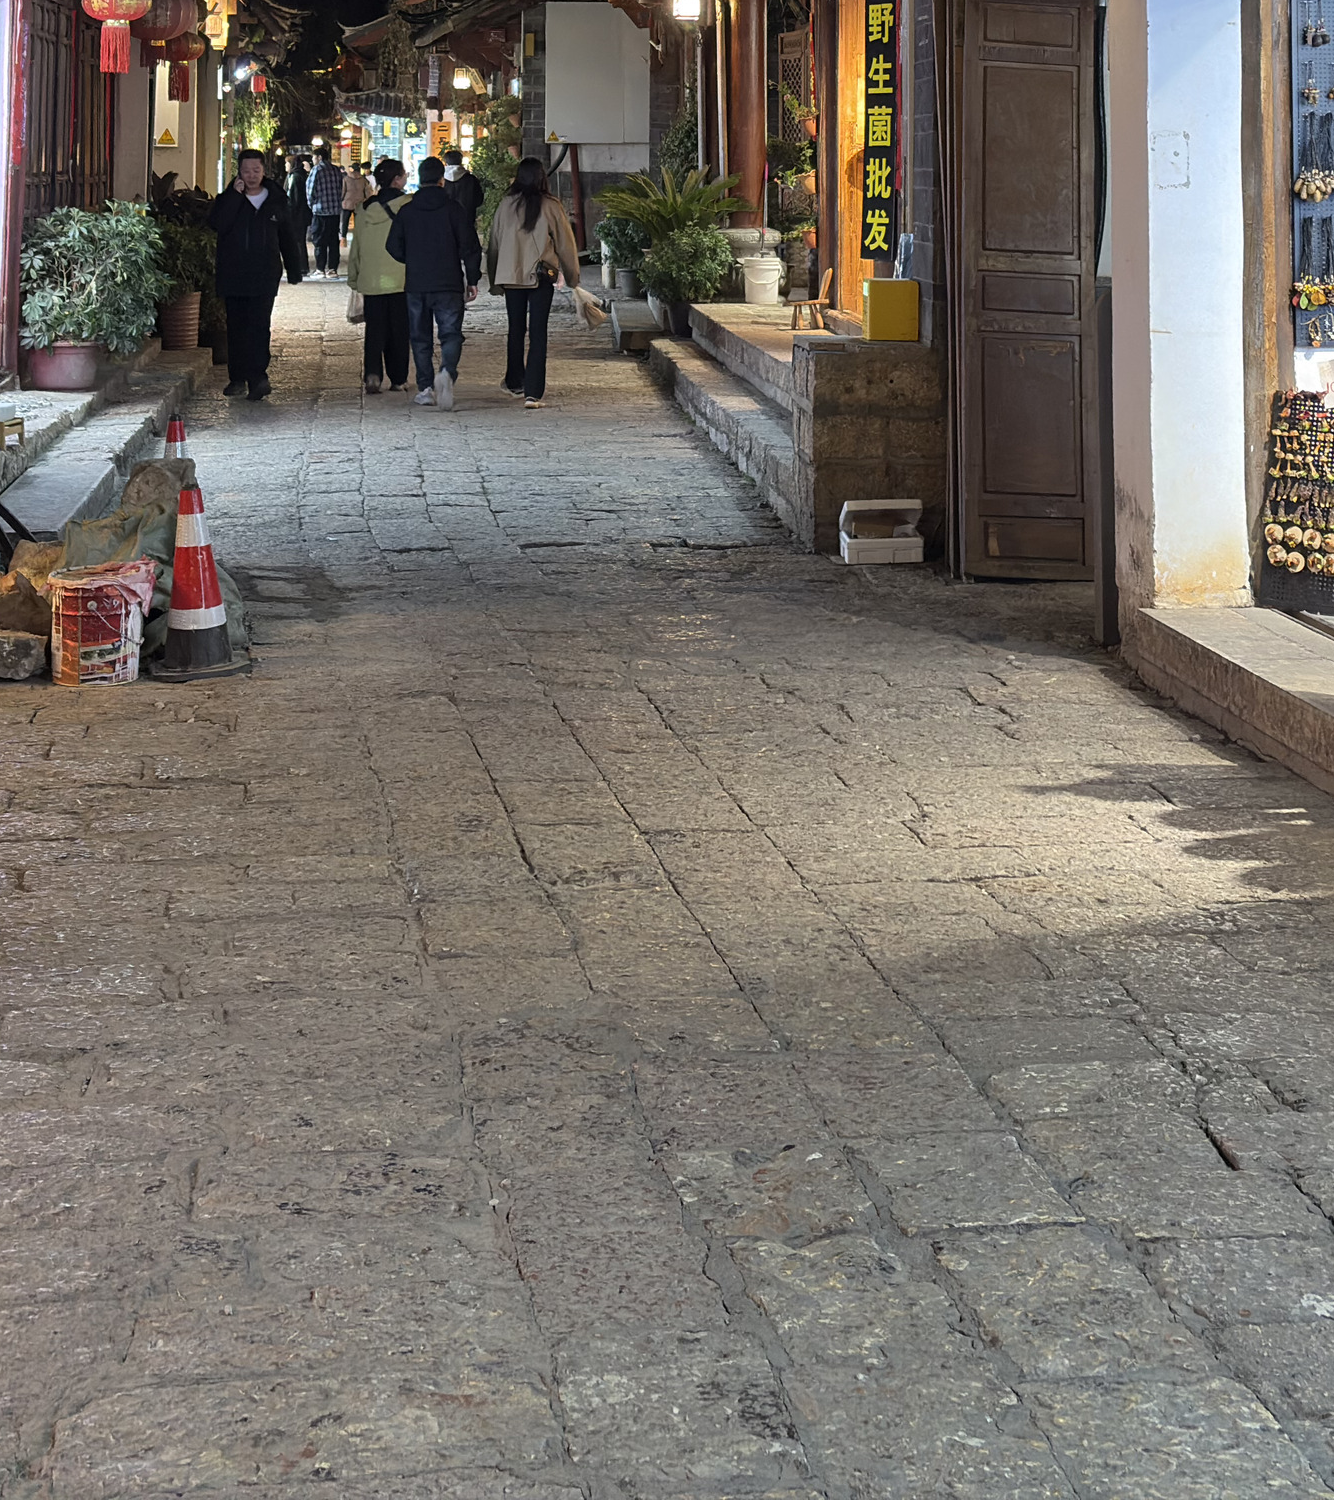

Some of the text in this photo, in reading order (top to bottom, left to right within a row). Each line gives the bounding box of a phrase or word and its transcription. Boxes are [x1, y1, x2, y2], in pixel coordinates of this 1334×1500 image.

[864, 3, 894, 251] 野生菌批发
